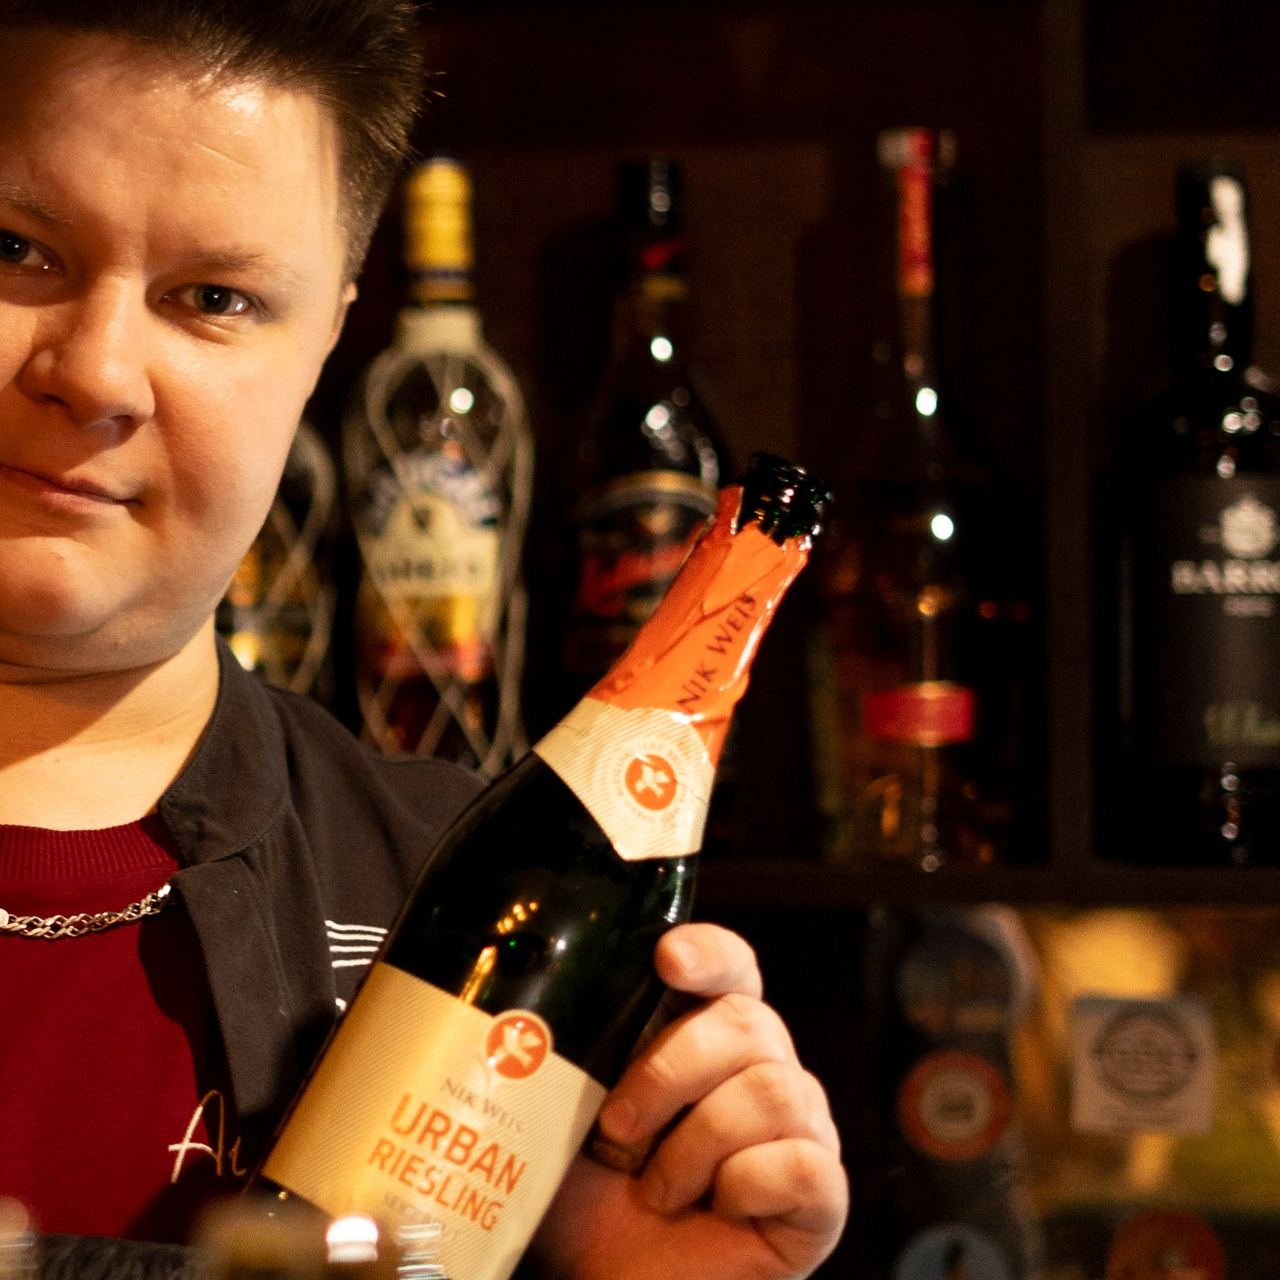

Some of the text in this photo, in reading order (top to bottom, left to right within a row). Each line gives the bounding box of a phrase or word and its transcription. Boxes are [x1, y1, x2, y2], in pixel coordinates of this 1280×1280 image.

[676, 592, 756, 714] NIK WEIS
[391, 1093, 527, 1196] URBAN
[440, 1077, 522, 1133] NIK WEIS
[368, 1136, 504, 1232] RIESLING
